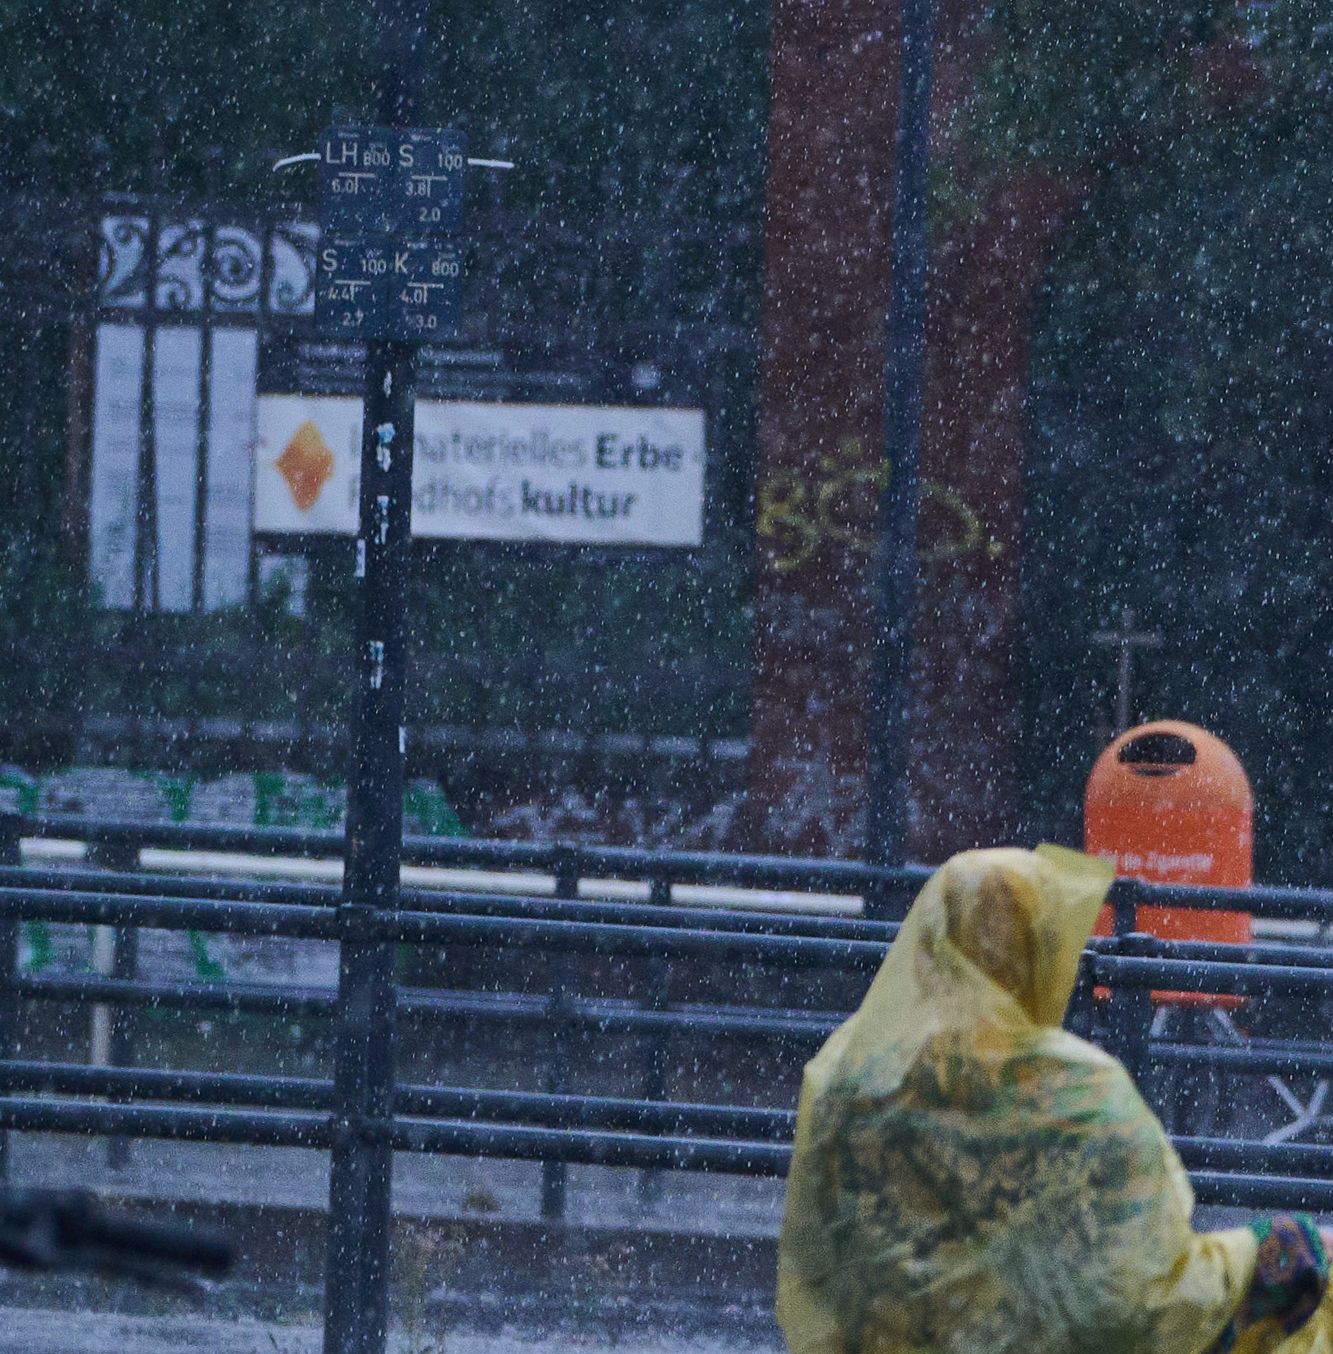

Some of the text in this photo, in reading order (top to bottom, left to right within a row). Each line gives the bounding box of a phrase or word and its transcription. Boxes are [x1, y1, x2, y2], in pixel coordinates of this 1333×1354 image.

[326, 141, 391, 166] LH 800
[399, 144, 463, 170] S 100
[331, 179, 354, 194] 6.0
[419, 206, 441, 223] 2.0
[322, 249, 387, 274] S 100
[394, 251, 459, 277] K 800
[415, 314, 437, 329] 3.0
[596, 432, 683, 472] Erbe
